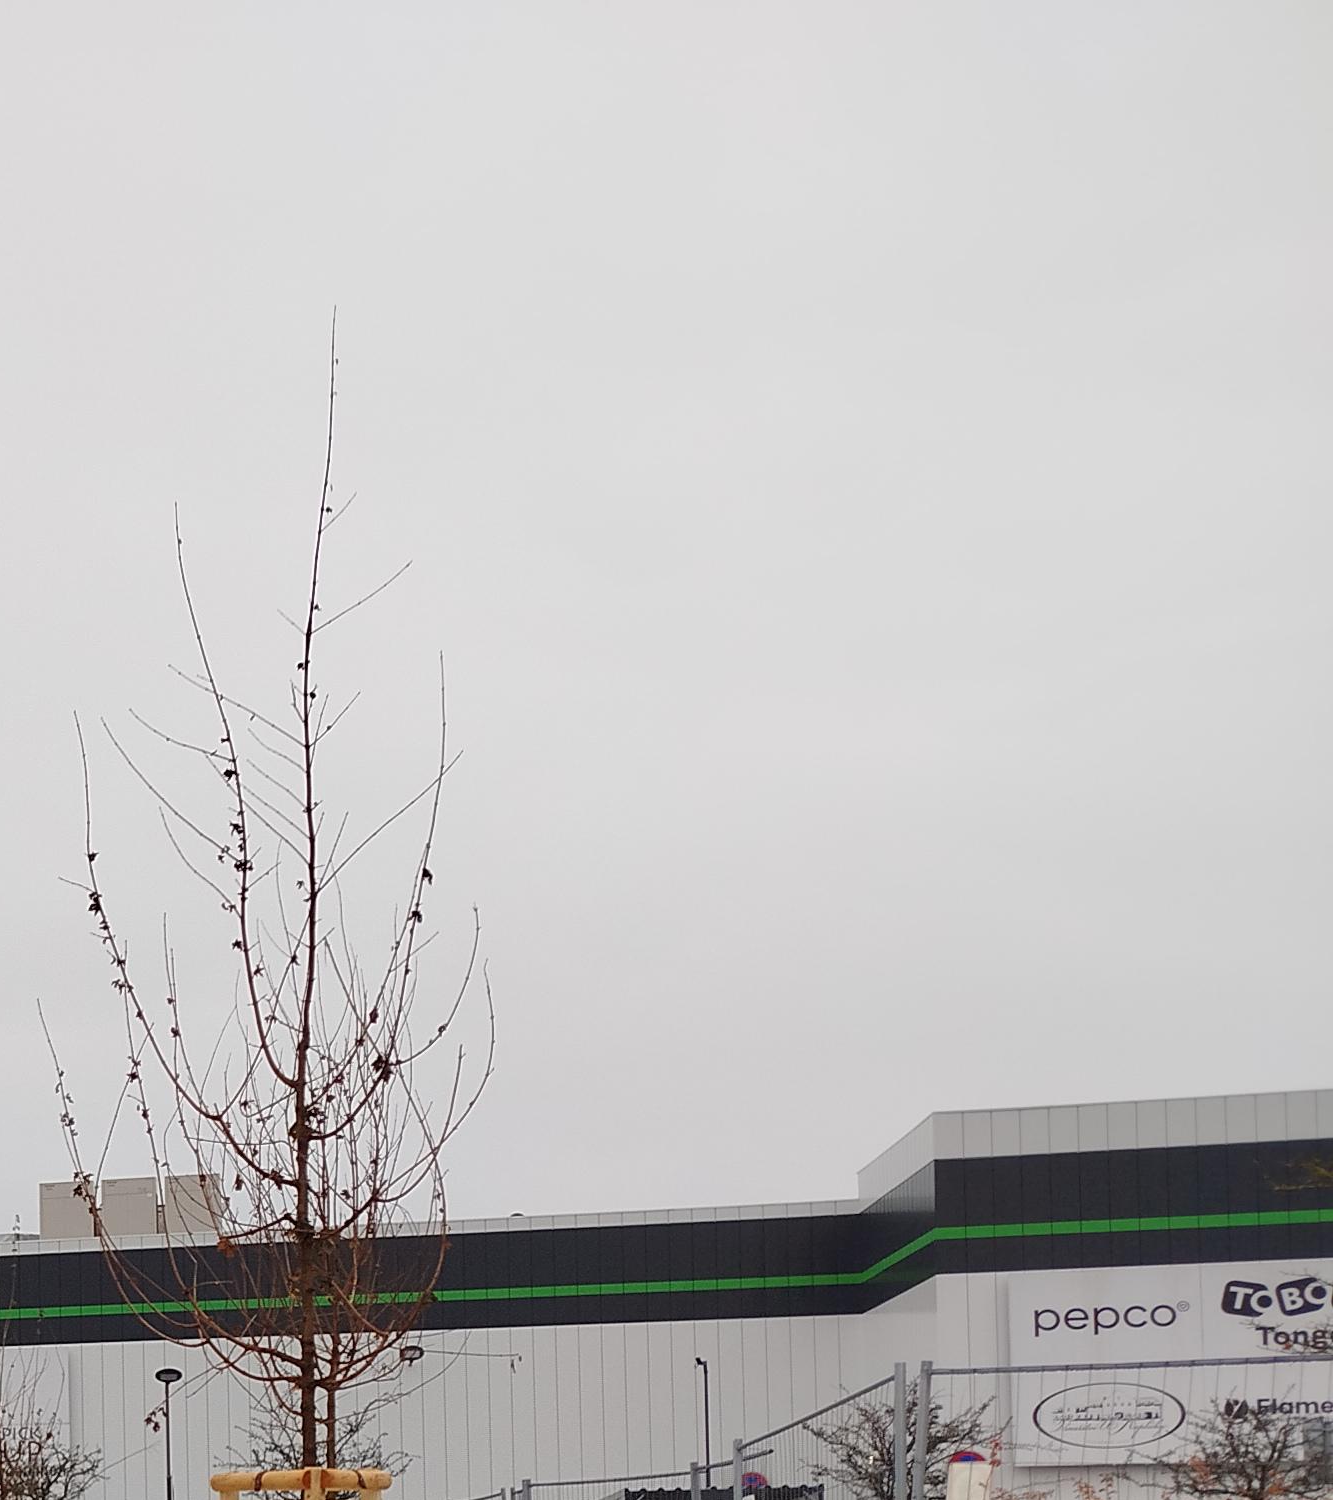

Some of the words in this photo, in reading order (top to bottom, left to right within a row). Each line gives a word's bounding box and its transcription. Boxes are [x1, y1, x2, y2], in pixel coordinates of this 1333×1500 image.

[1227, 1279, 1333, 1315] TOBO
[1033, 1303, 1177, 1337] pepco
[1255, 1325, 1333, 1350] Tong
